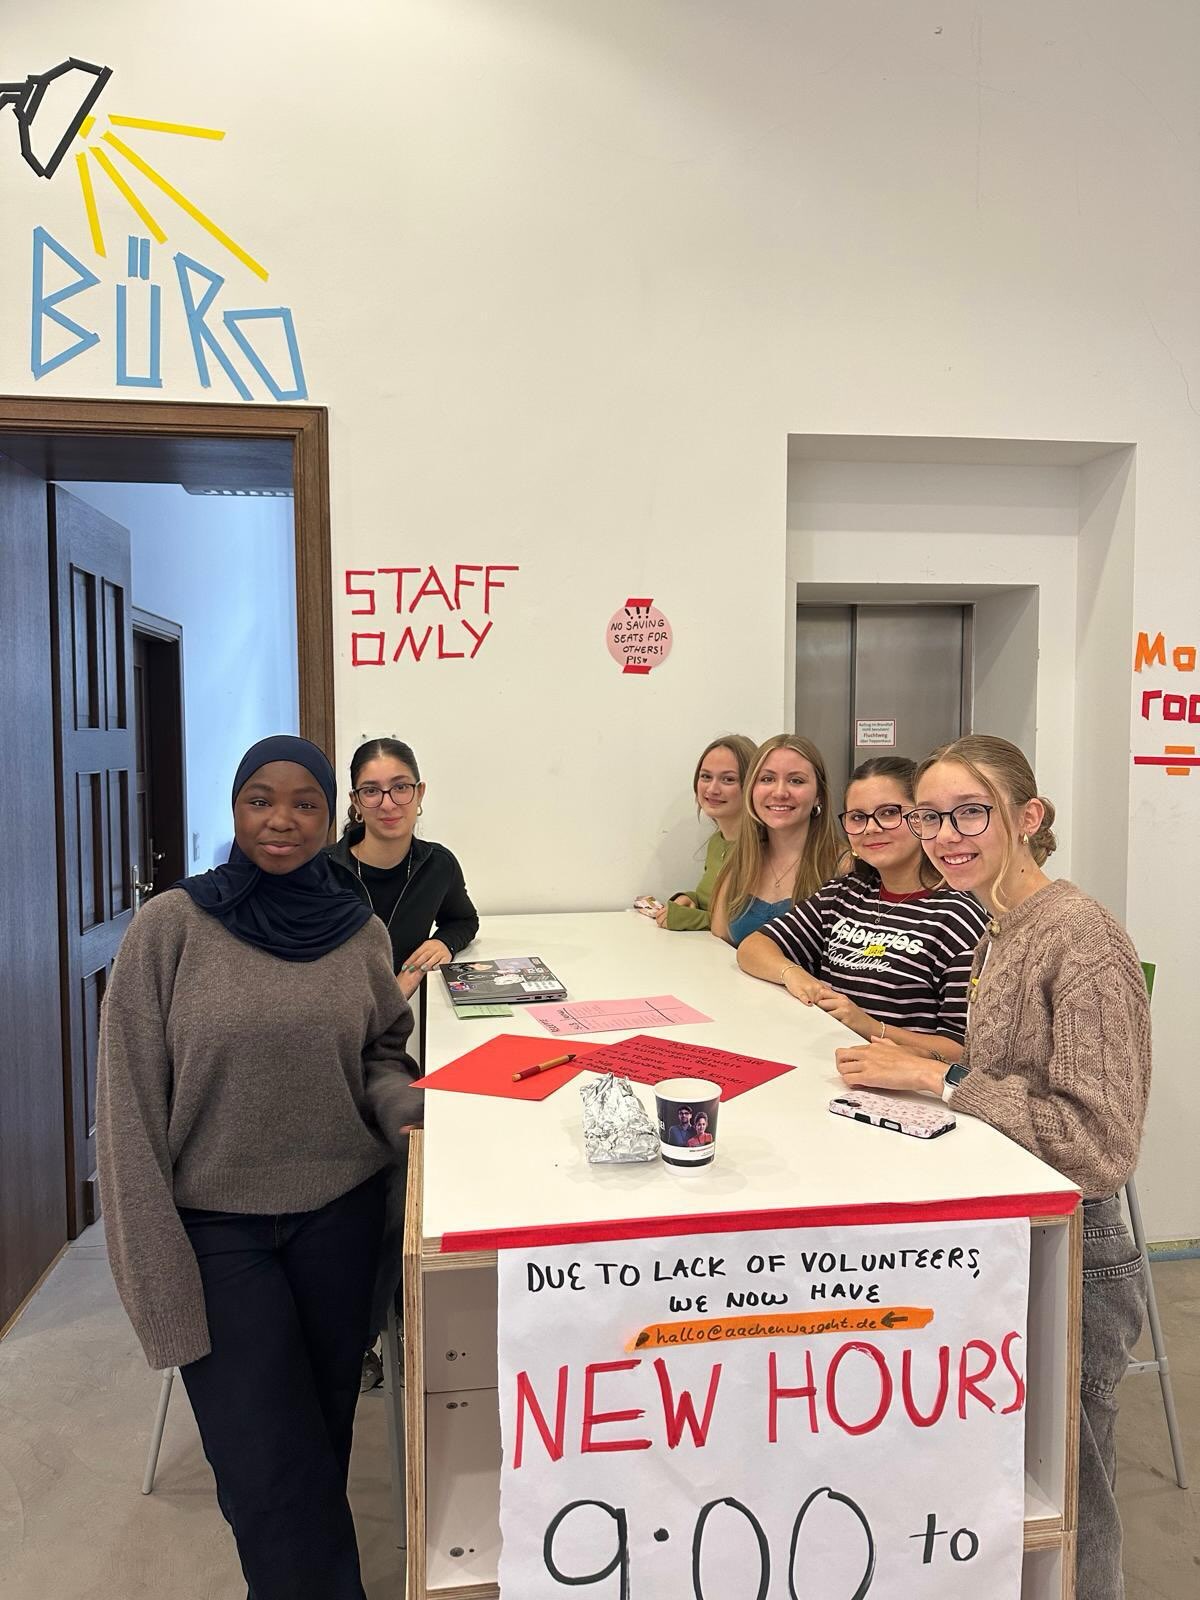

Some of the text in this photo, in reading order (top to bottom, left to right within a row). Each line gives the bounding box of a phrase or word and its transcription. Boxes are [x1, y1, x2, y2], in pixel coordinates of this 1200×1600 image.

[30, 225, 308, 402] BÜRO
[345, 565, 519, 615] STAFF
[351, 619, 493, 666] ONLY
[610, 619, 664, 631] NO SAVING
[613, 632, 668, 643] SEATS FOR
[622, 645, 663, 655] OTHERS!
[527, 1247, 981, 1292] DUE TO LACK OF VOLUNTEERS,
[669, 1282, 881, 1313] WE NOW HAVE
[513, 1331, 1025, 1469] NEW HOURS
[909, 1512, 979, 1564] to
